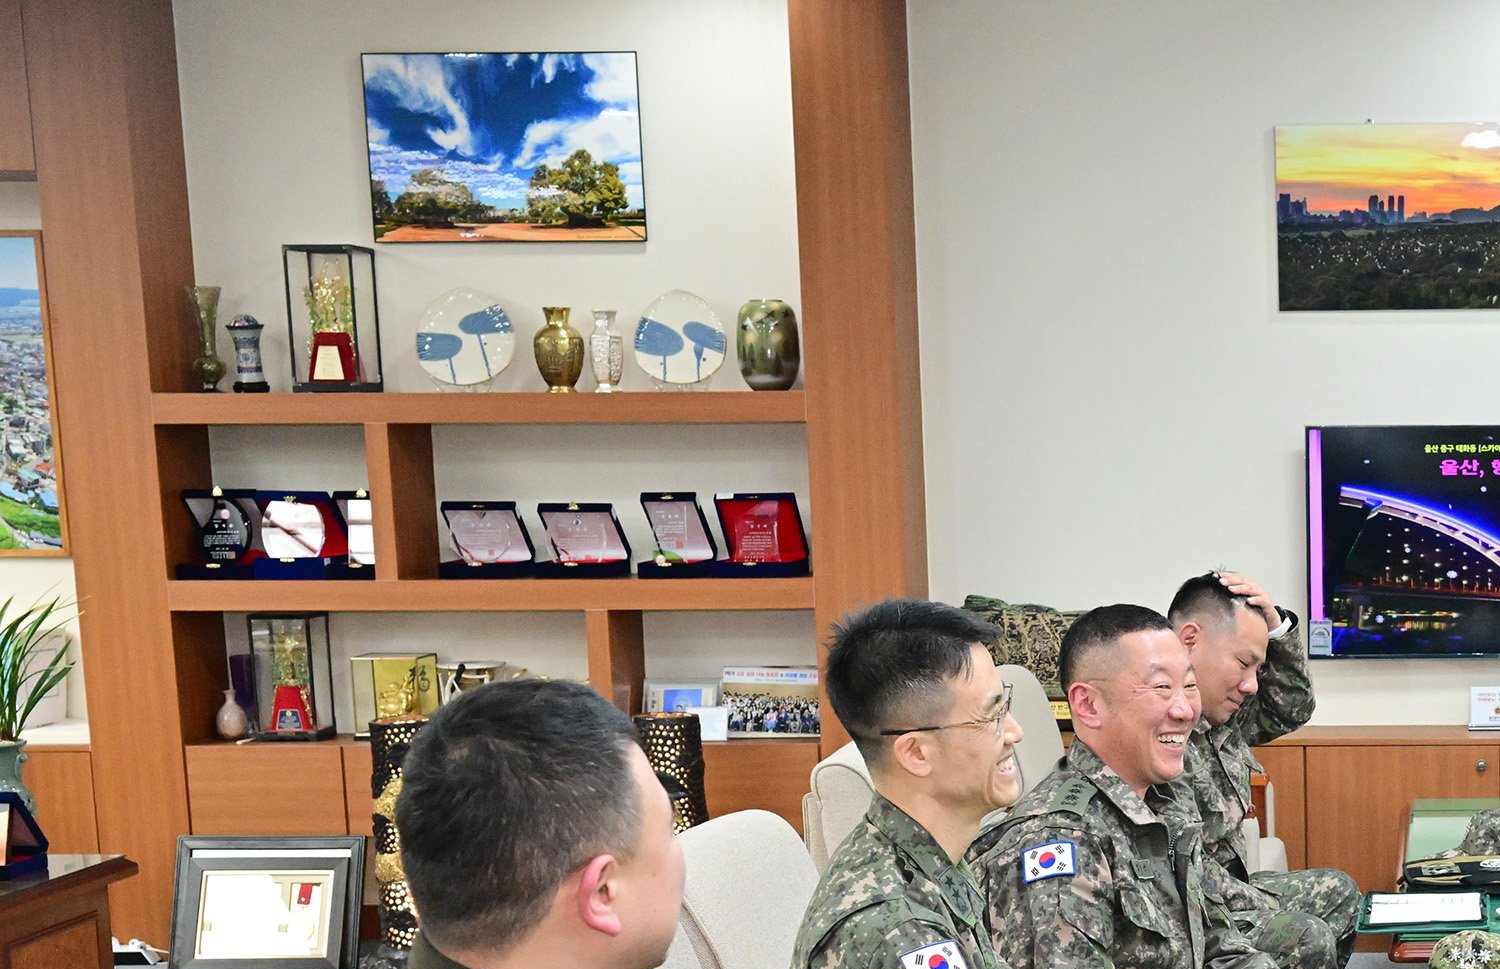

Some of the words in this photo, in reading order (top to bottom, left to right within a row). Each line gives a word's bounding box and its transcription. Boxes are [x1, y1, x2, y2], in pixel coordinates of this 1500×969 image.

[1424, 443, 1439, 453] 울산
[1440, 444, 1454, 453] 중구
[1439, 459, 1485, 478] 울산,
